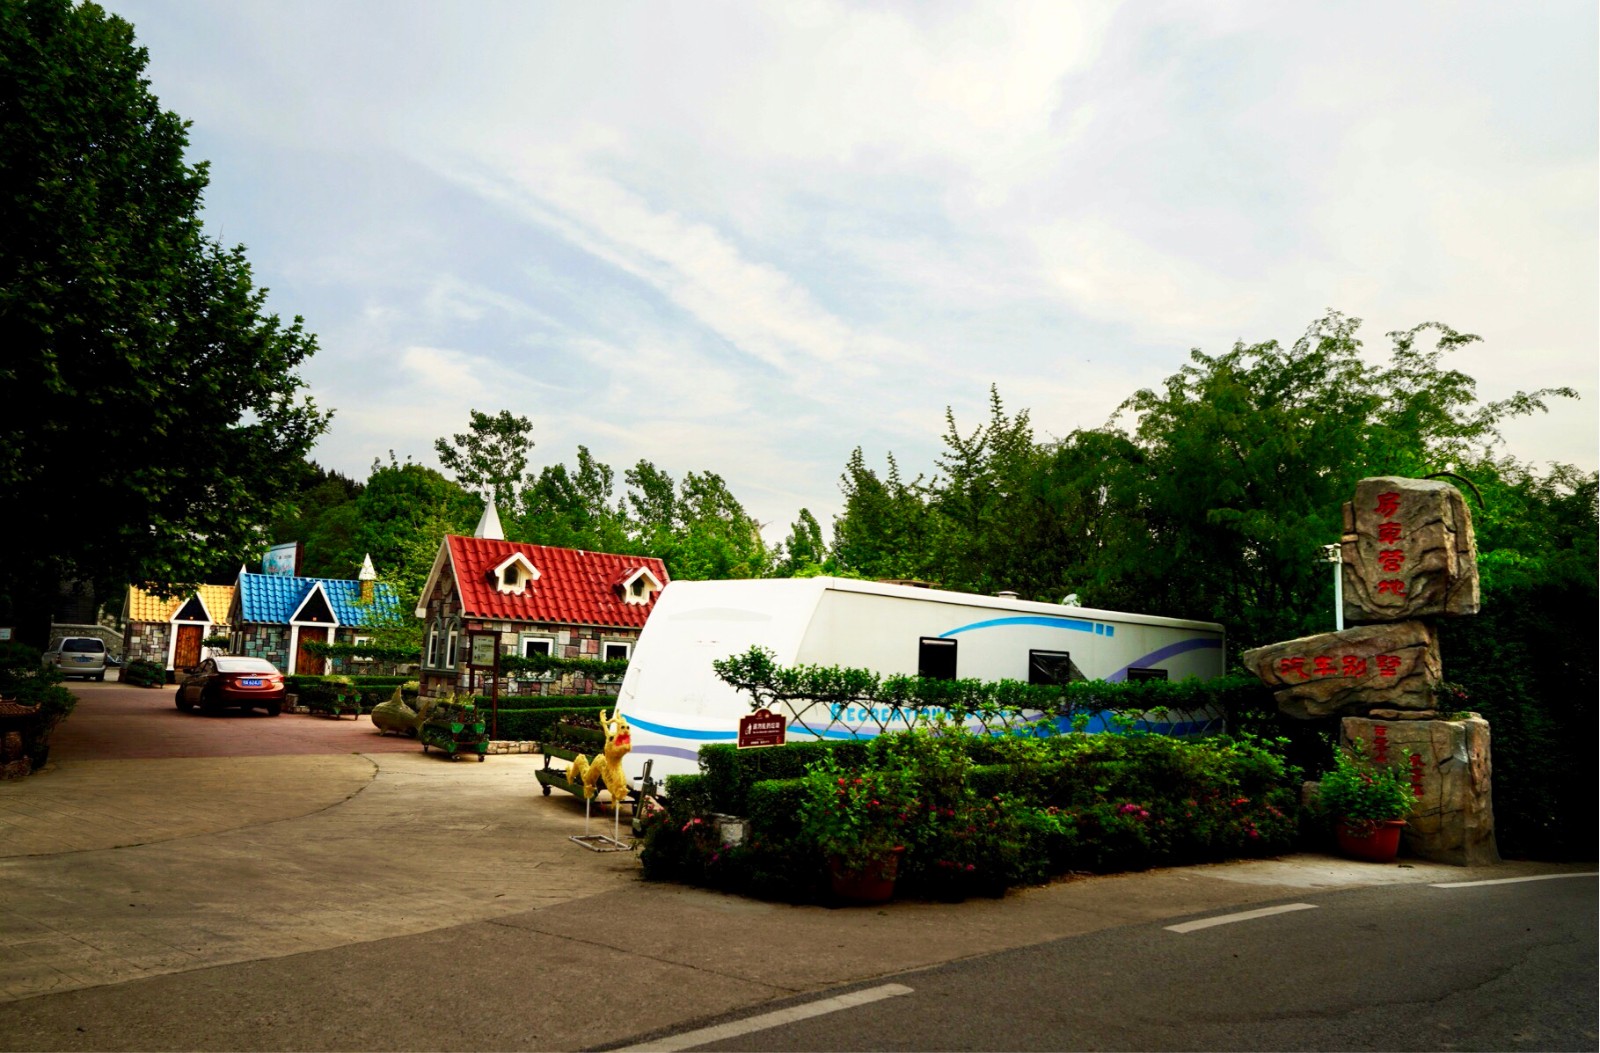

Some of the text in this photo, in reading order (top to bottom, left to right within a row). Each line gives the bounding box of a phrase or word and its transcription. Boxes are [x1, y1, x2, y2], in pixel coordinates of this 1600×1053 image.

[1279, 655, 1402, 680] 汽车别墅
[830, 702, 962, 722] RECREATION
